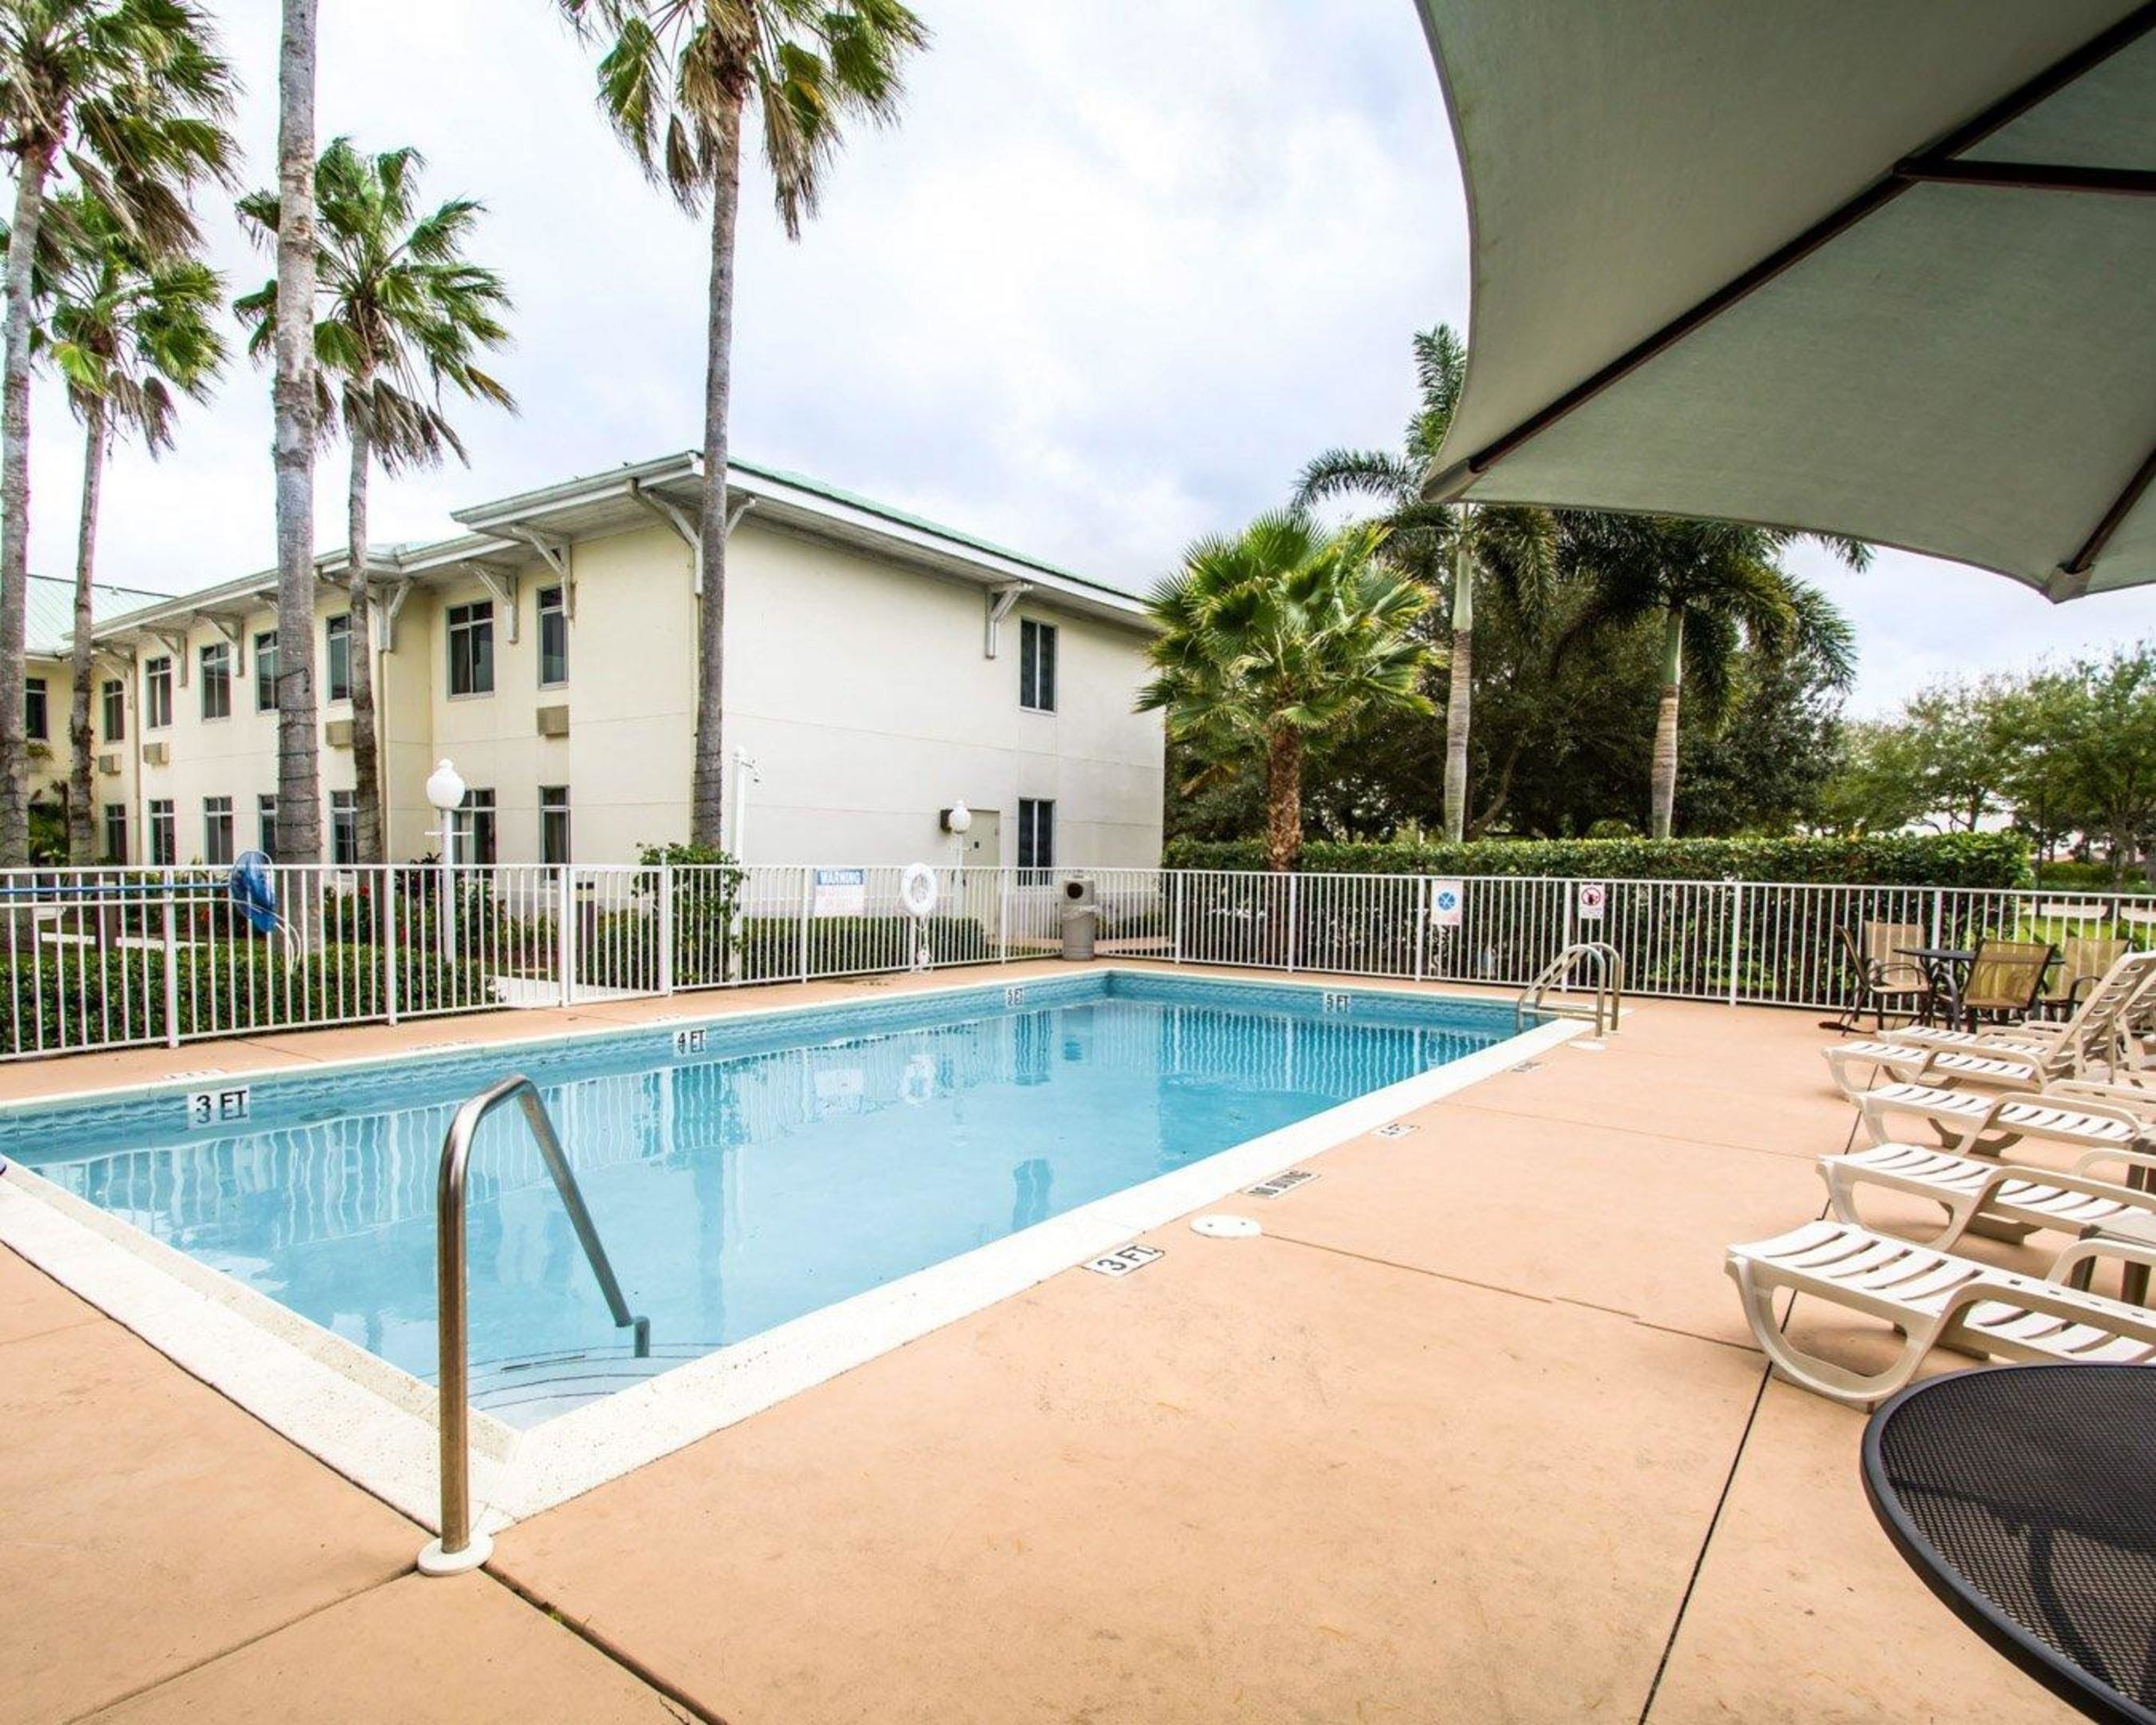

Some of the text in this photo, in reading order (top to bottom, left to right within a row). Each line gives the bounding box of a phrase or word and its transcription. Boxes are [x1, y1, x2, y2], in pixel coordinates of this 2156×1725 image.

[820, 871, 861, 884] WARNING
[1327, 994, 1349, 1008] 5 FT
[677, 1029, 705, 1044] 4 FT
[195, 1090, 247, 1113] 3 FT
[1097, 1259, 1127, 1271] 3
